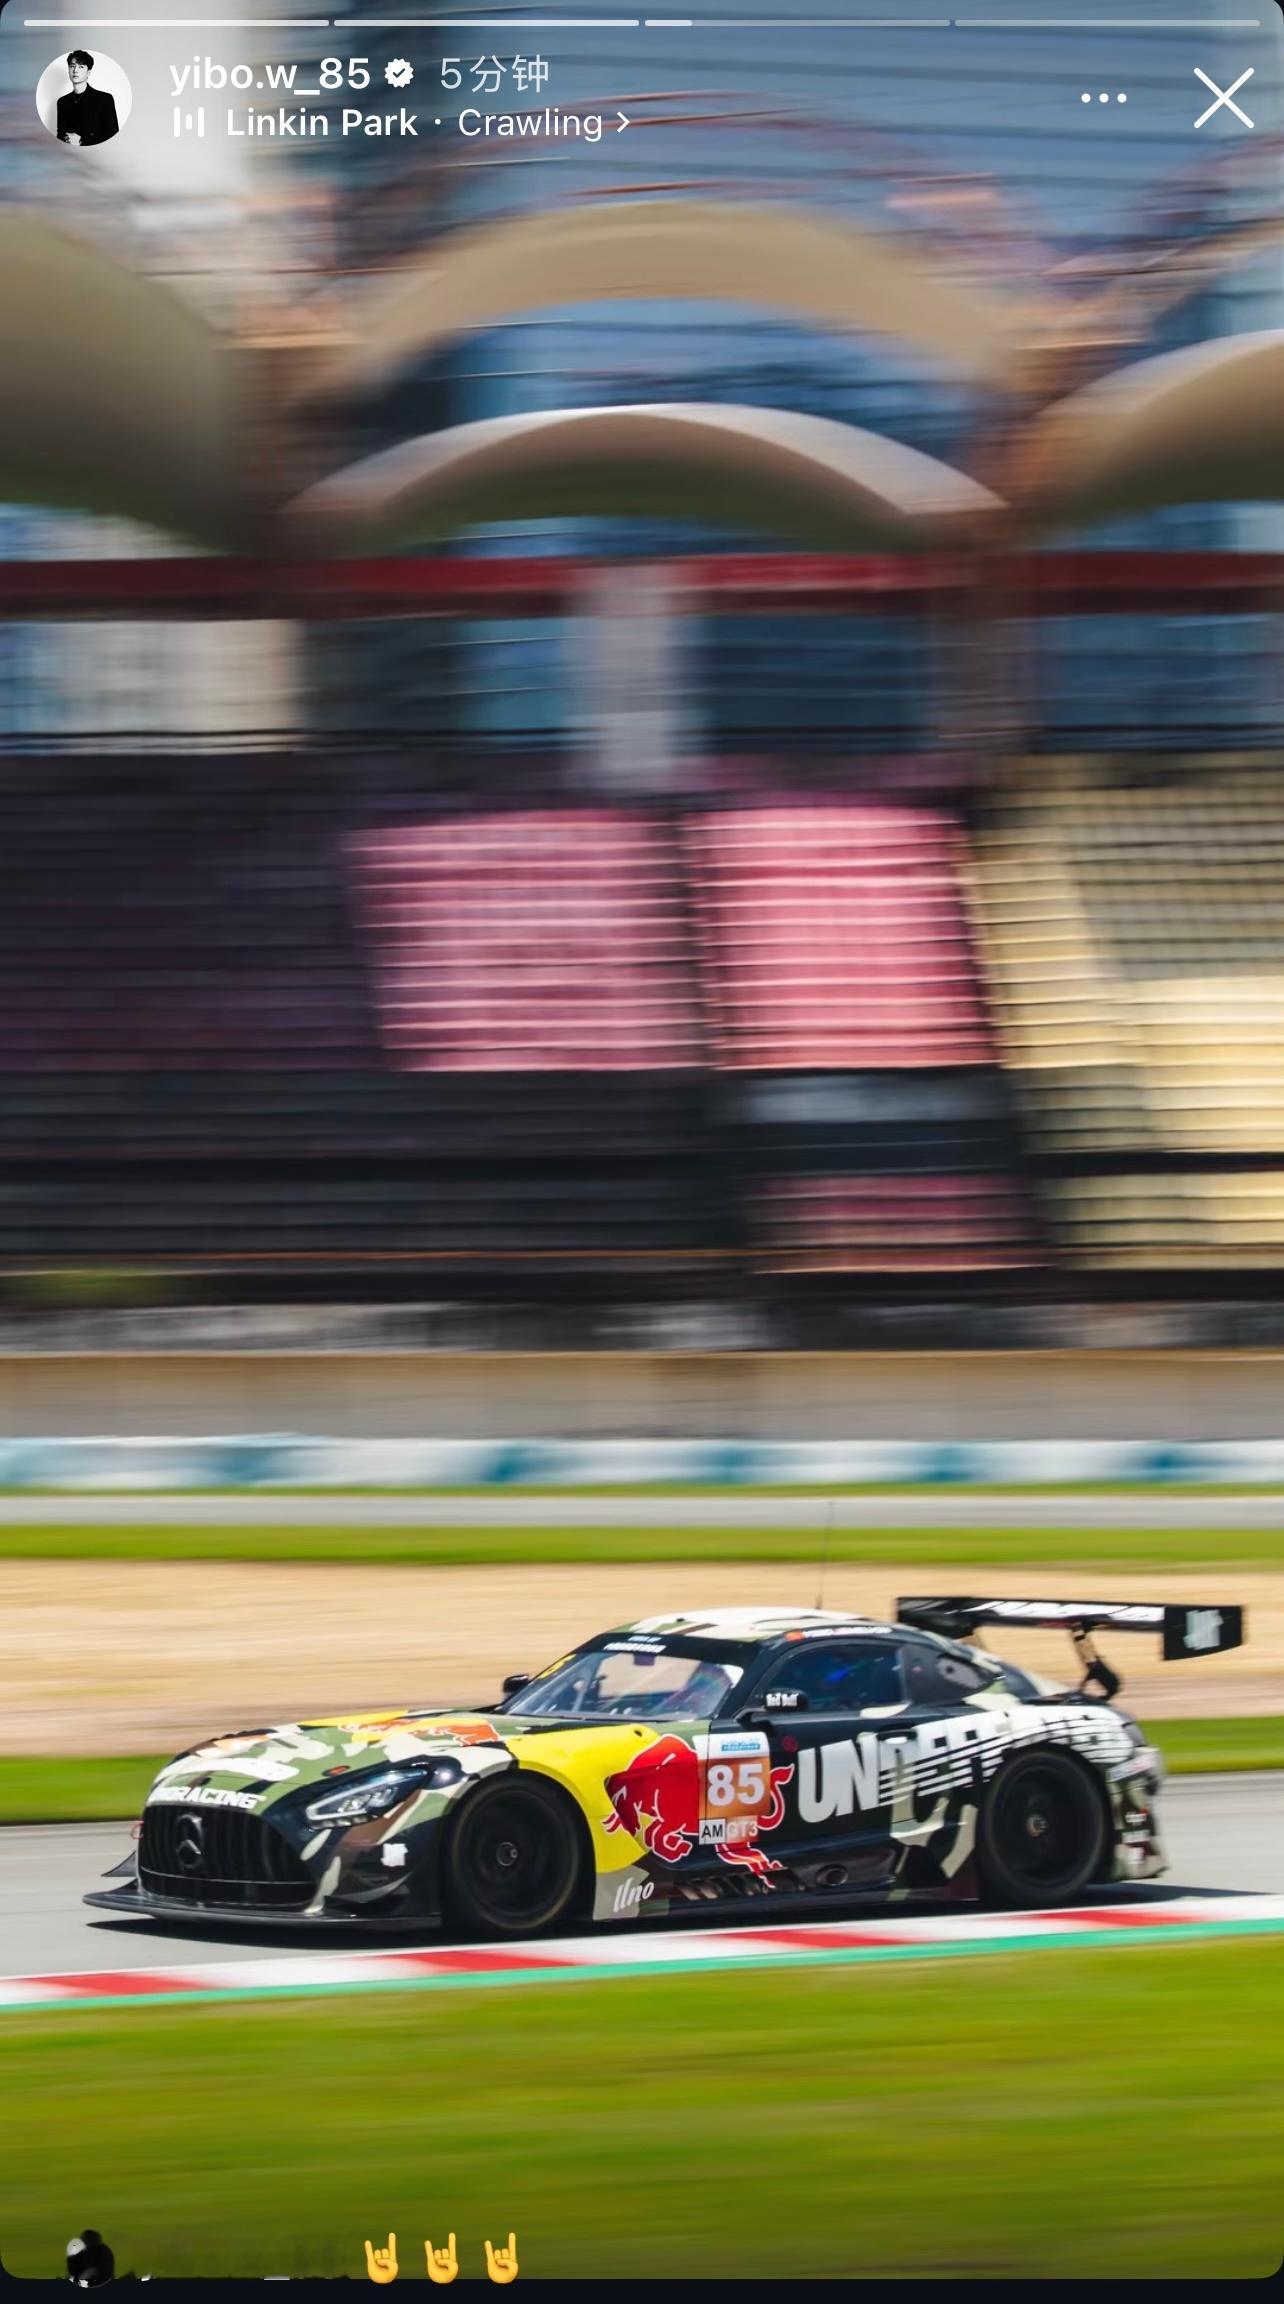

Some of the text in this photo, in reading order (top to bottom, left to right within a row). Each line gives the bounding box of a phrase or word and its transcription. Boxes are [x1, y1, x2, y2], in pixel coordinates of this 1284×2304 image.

[707, 1763, 765, 1807] 85
[701, 1820, 759, 1839] AM GT3
